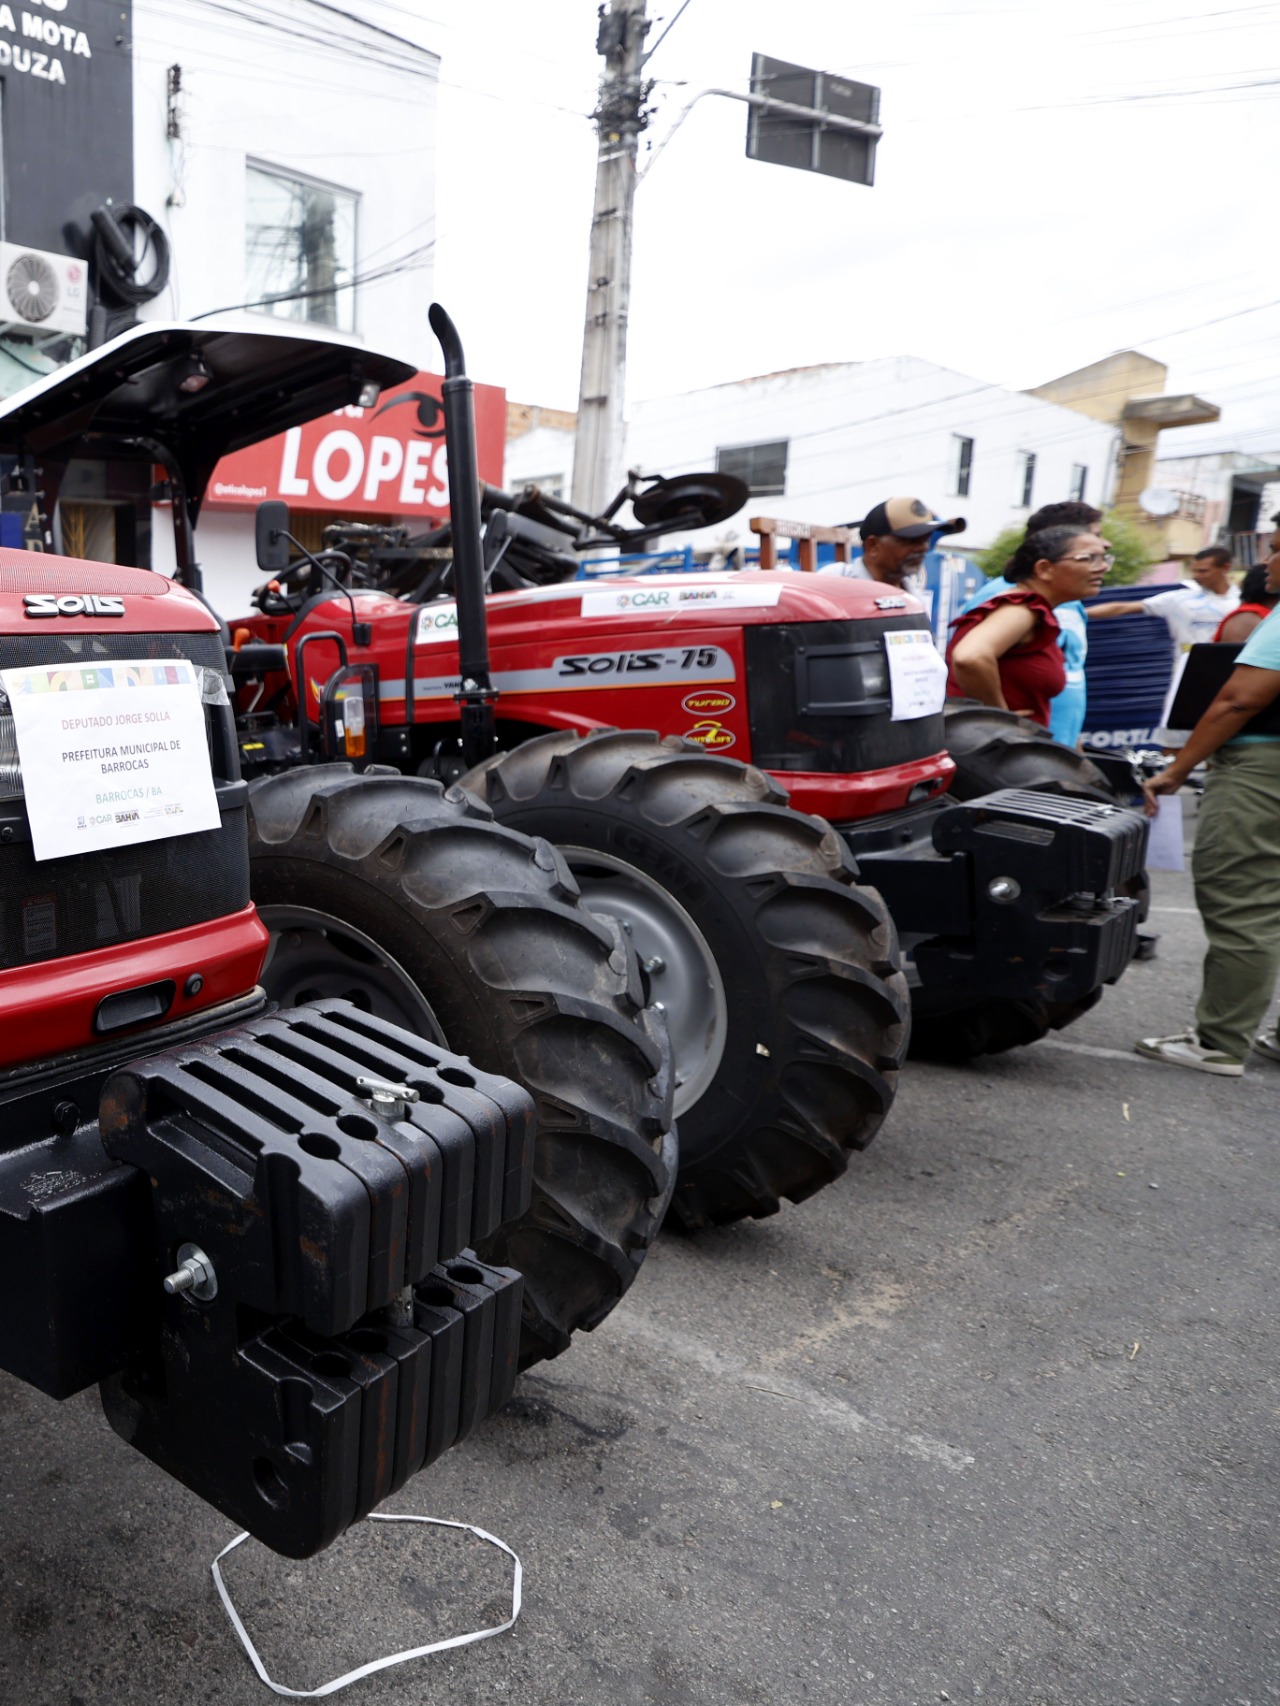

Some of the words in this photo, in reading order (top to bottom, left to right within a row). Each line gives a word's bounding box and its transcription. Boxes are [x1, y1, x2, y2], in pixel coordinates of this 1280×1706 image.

[22, 11, 92, 58] MOTA
[278, 426, 451, 507] LOPES
[631, 591, 670, 607] CAR
[434, 613, 458, 629] CA
[61, 715, 113, 731] DEPUTADO
[115, 713, 143, 726] JORGE
[144, 710, 171, 723] SOLLA
[1078, 727, 1160, 748] FORTL
[61, 747, 118, 763] PREFEITURA
[120, 741, 169, 756] MUNICIPAL
[169, 739, 182, 751] DE
[100, 759, 150, 774] BARROCAS
[95, 788, 144, 804] BARROCAS
[151, 786, 163, 796] BA
[95, 813, 113, 824] CAR
